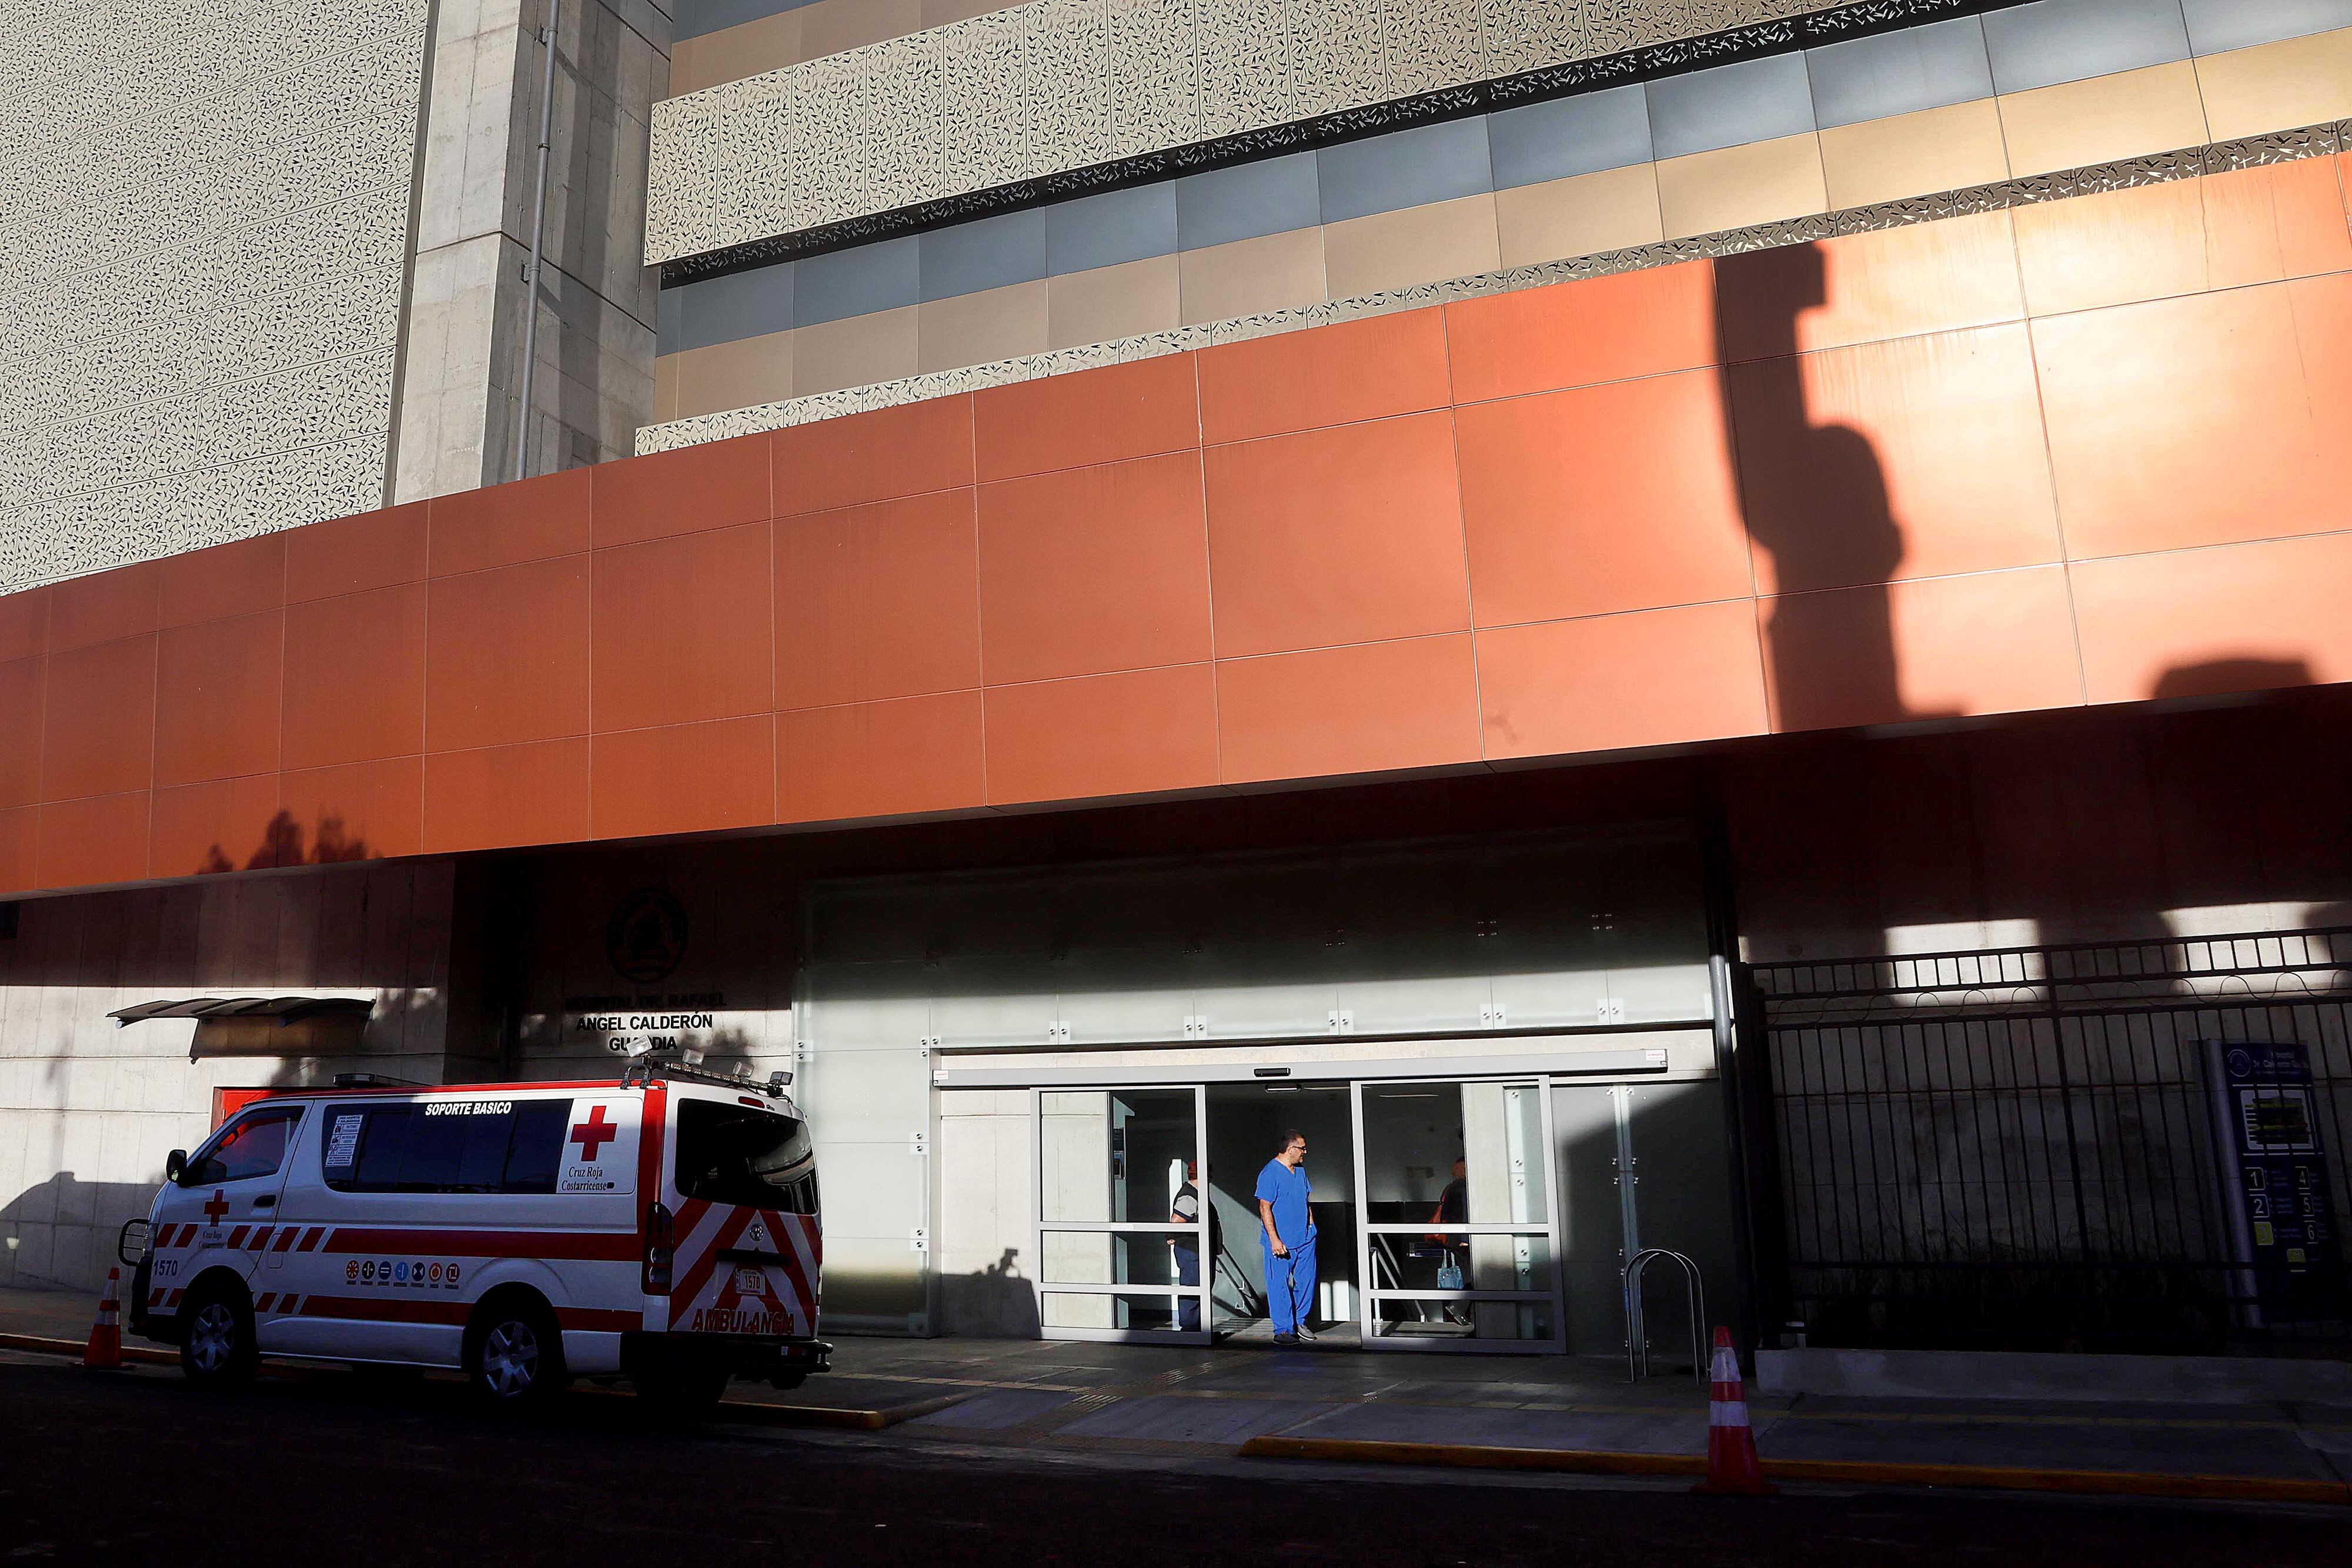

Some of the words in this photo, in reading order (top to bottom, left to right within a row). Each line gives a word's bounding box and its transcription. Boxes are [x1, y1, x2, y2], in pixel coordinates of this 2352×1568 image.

[576, 1017, 626, 1031] ANGEL
[630, 1011, 713, 1029] CALDERÓN
[609, 1036, 677, 1051] GUDIA
[425, 1103, 473, 1116] SOPORTE
[473, 1102, 512, 1115] BASICO
[569, 1166, 586, 1178] Cruz
[587, 1166, 603, 1180] Roja
[2250, 1171, 2258, 1188] 1
[2298, 1170, 2306, 1186] 4
[562, 1180, 607, 1191] Costarricense
[2253, 1198, 2264, 1214] 2
[2303, 1196, 2311, 1213] 5
[2307, 1224, 2315, 1241] 6
[153, 1259, 178, 1276] 1570
[745, 1275, 760, 1289] 1570
